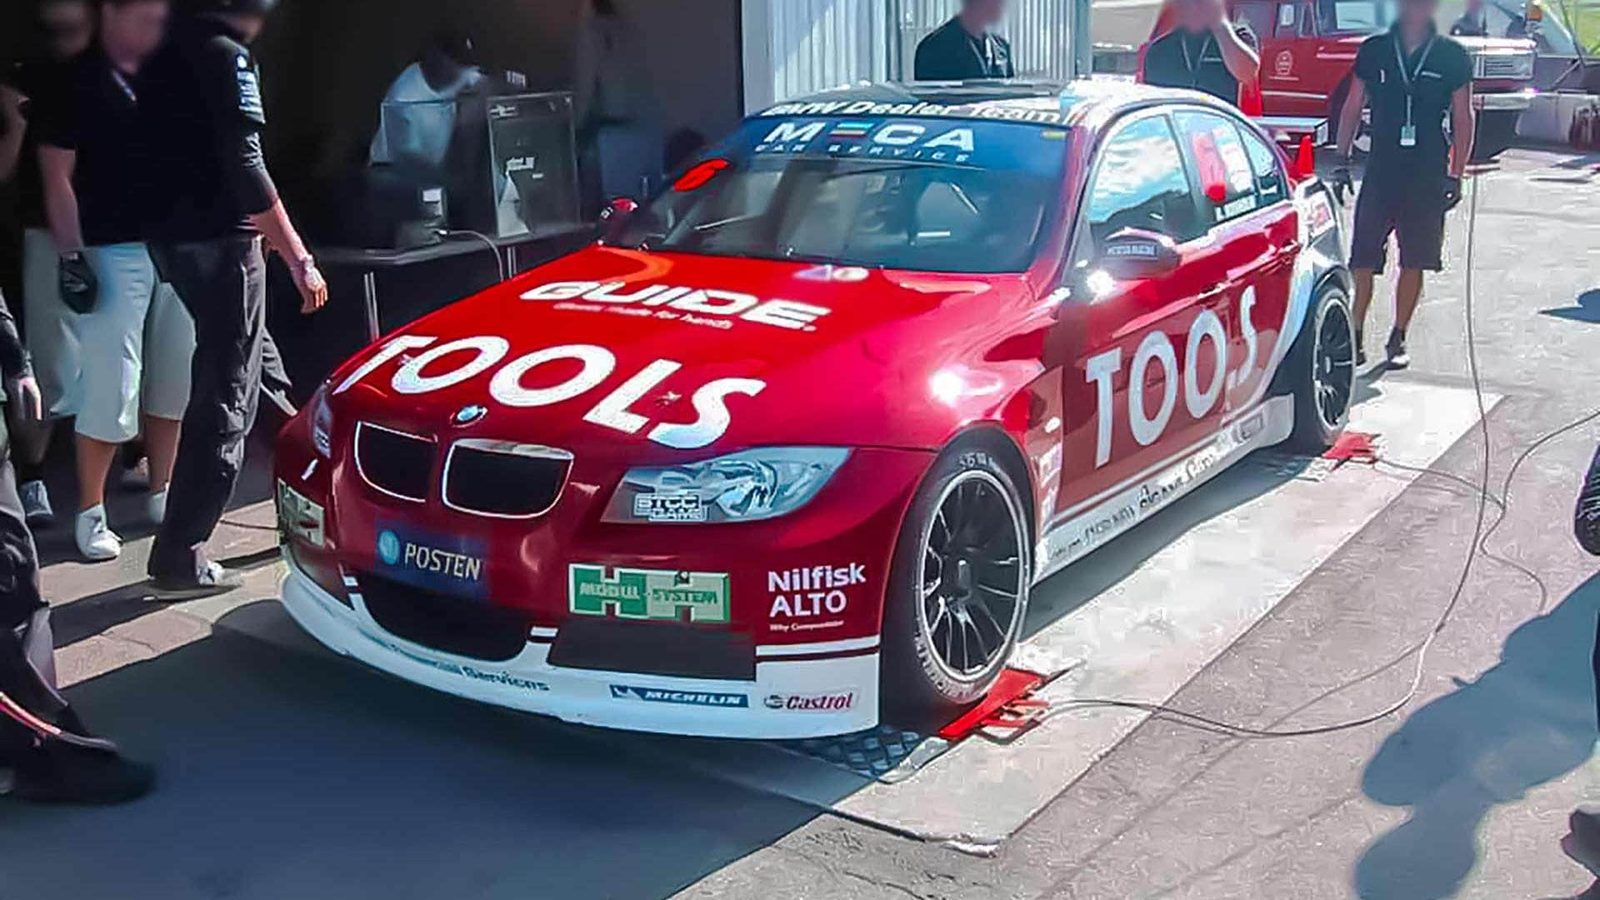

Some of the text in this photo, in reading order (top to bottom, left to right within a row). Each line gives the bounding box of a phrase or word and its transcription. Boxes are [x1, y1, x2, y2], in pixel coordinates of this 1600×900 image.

[846, 101, 956, 117] Dealer
[967, 108, 1060, 122] Team
[1085, 284, 1257, 469] TOOS
[332, 335, 766, 449] TOOLS
[404, 542, 481, 581] POSTEN
[767, 563, 866, 593] Nilfisk
[769, 590, 847, 618] ALTO
[643, 690, 742, 706] MICHELIN
[786, 692, 853, 710] Castrol
